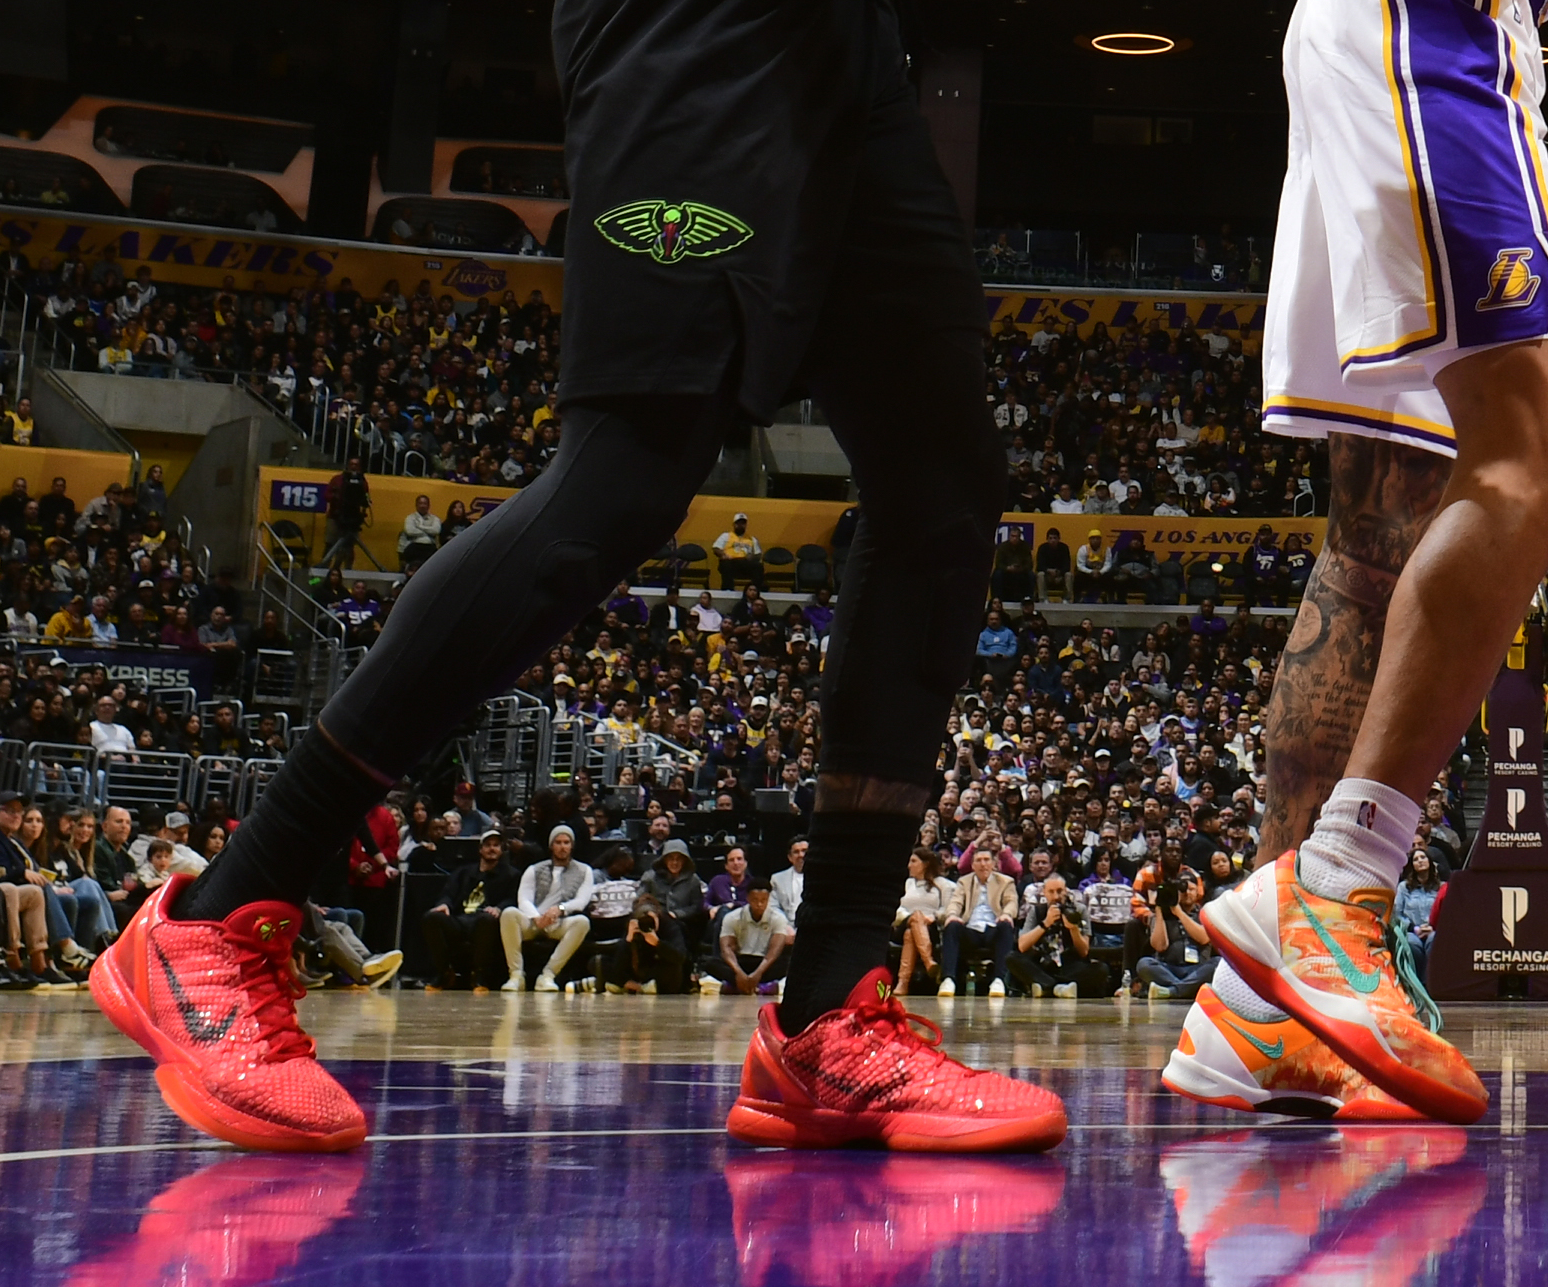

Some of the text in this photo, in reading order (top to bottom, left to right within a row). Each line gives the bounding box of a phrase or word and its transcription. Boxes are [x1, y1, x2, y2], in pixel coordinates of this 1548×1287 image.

[44, 222, 339, 278] LAKERS
[279, 484, 319, 508] 115
[1152, 529, 1198, 544] LOS
[1494, 762, 1538, 770] PECHANGA
[1487, 831, 1542, 841] PECHANGA
[1473, 963, 1510, 972] RESORT
